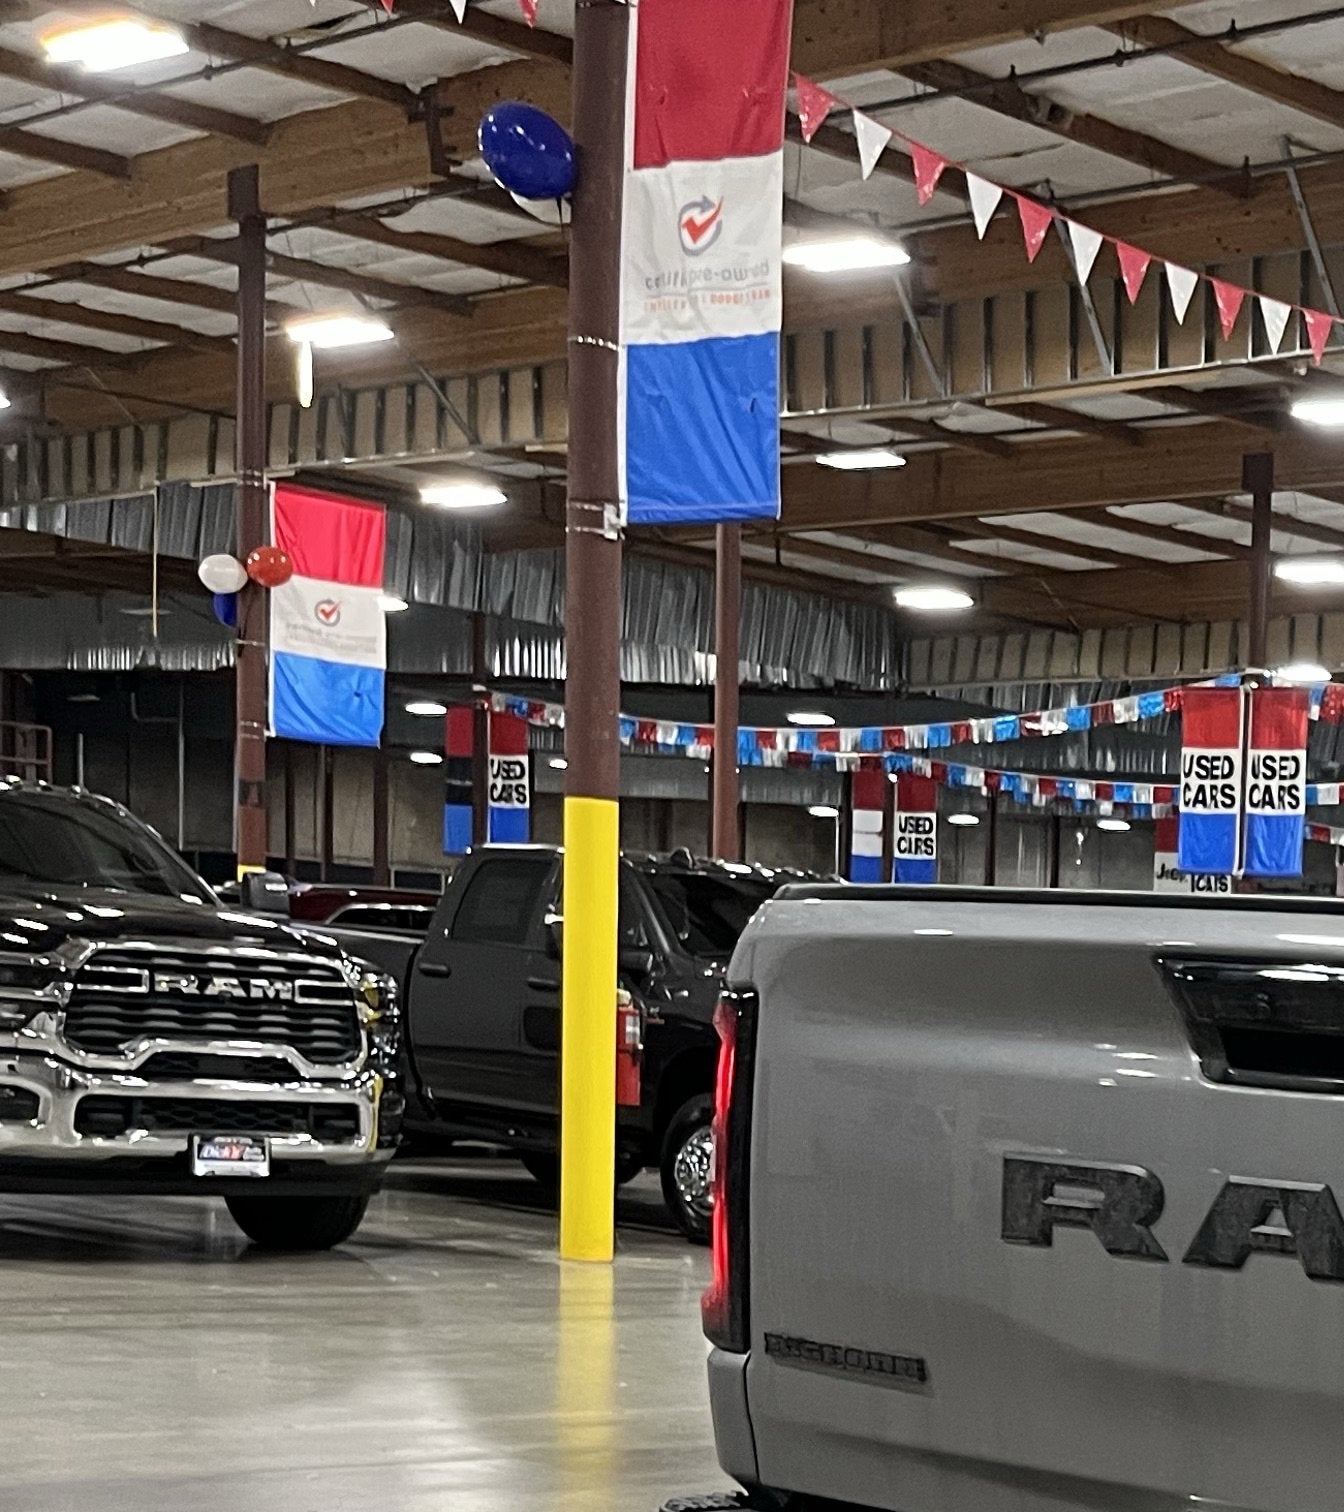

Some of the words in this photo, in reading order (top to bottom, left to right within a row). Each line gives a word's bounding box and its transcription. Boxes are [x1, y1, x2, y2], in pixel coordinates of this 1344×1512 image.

[1183, 754, 1235, 780] USED
[1251, 754, 1301, 780] USED
[1183, 782, 1236, 808] CARS
[1249, 783, 1301, 810] CARS
[899, 815, 934, 835] USED
[154, 972, 293, 1000] RAM
